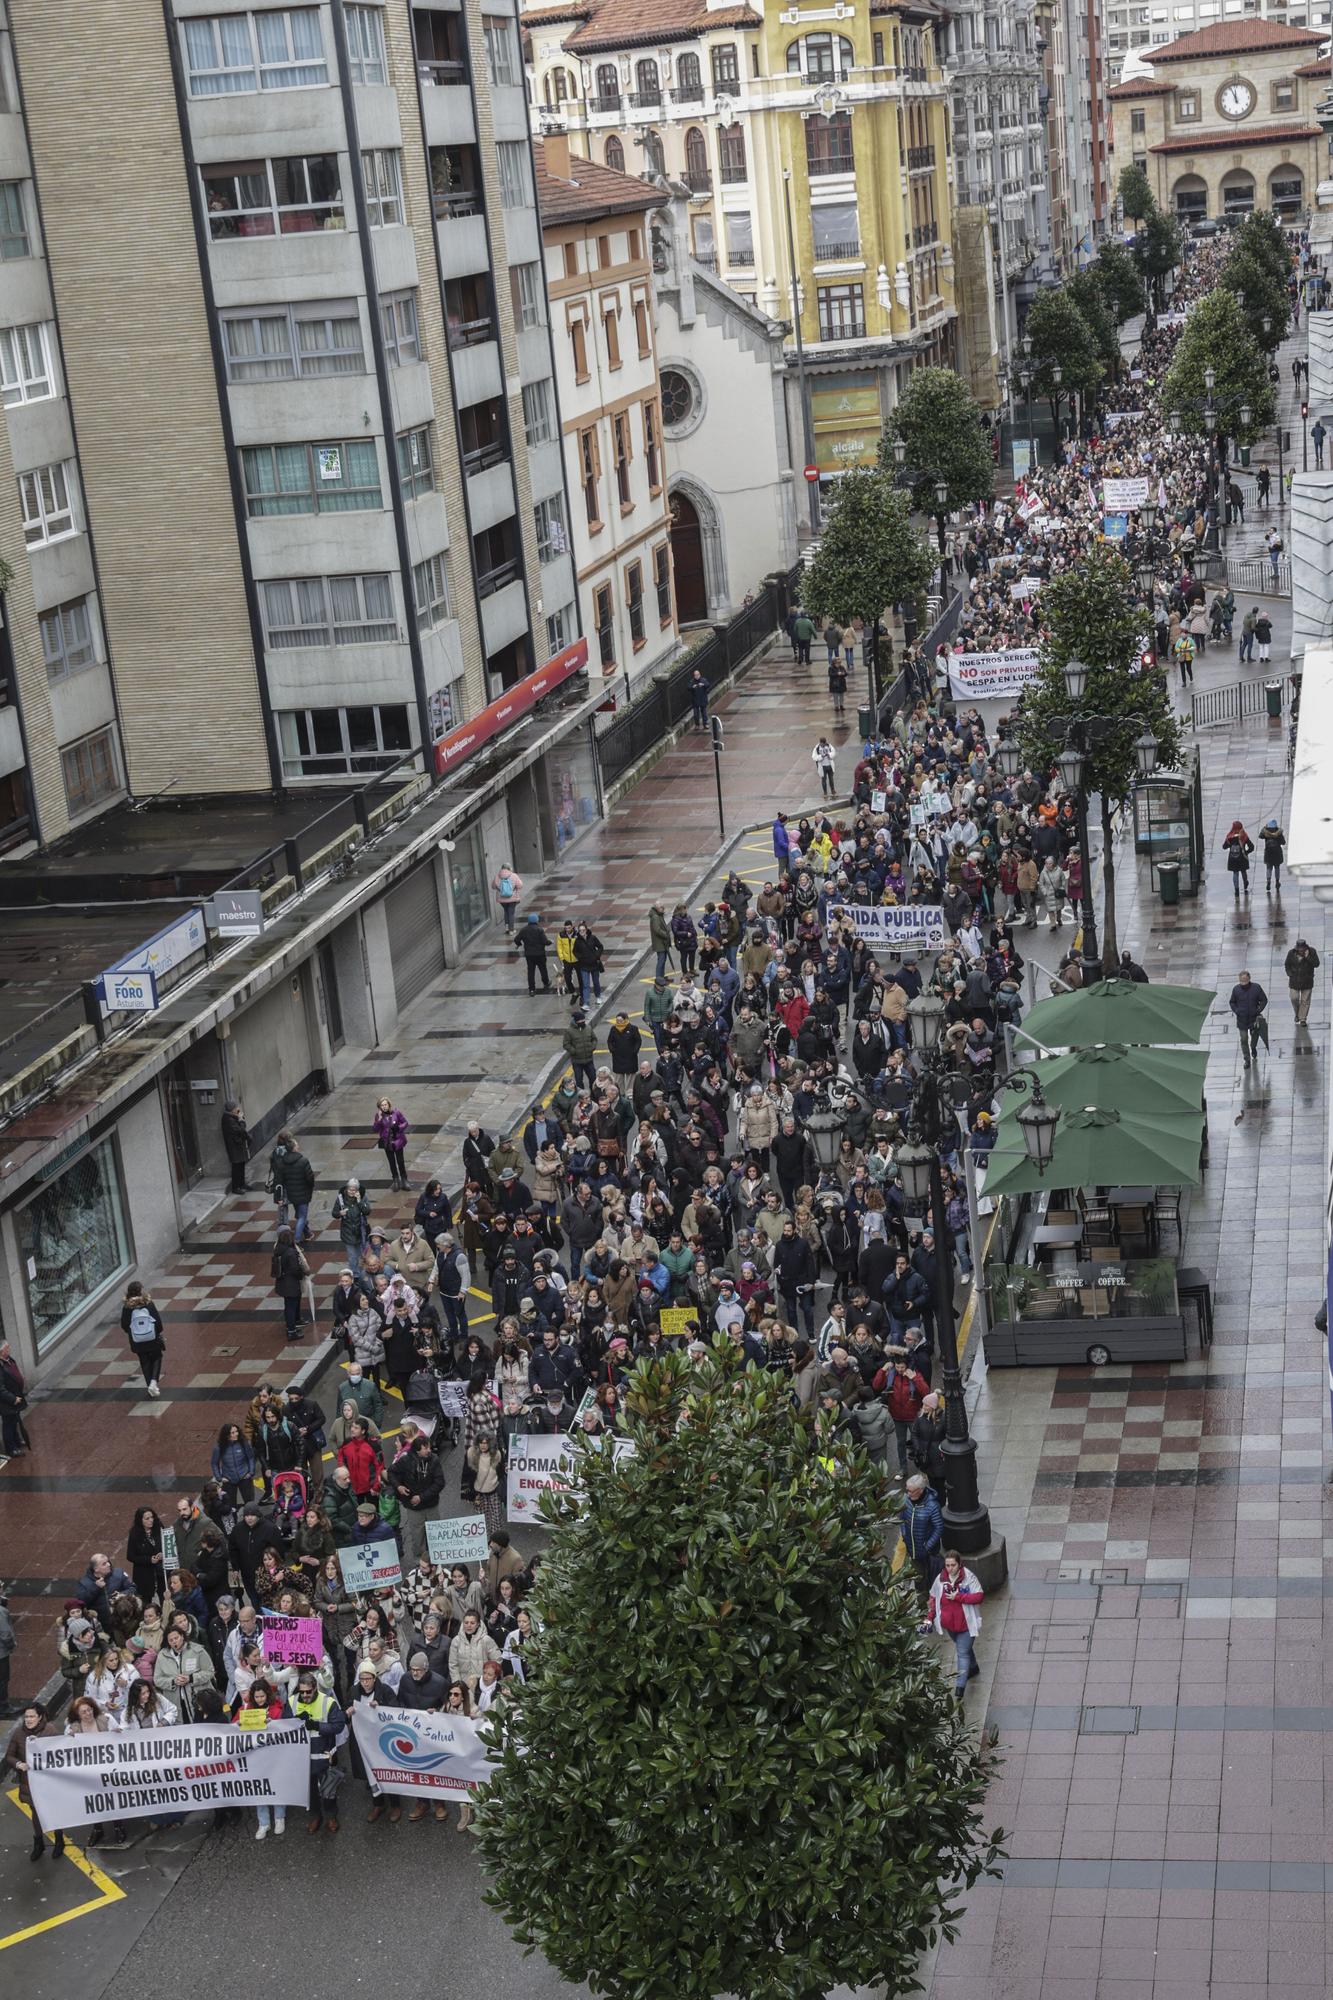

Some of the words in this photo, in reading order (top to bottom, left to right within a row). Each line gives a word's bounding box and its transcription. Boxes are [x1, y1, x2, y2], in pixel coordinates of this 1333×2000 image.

[959, 657, 1002, 667] NUESTROS
[960, 668, 978, 679] NO
[967, 678, 996, 687] SESPA
[219, 910, 257, 920] maestro
[115, 987, 143, 999] FORO
[116, 1000, 145, 1008] Asturias
[1056, 1278, 1084, 1287] COFFEE
[1098, 1277, 1126, 1286] COFFEE
[437, 1521, 486, 1541] APLAUSOS
[433, 1546, 485, 1561] DERECHOS
[371, 1566, 400, 1579] PRECARIO
[263, 1617, 299, 1631] NUESTROS
[268, 1651, 284, 1663] DEL
[288, 1652, 318, 1665] SESPA
[378, 1711, 394, 1723] Ola
[398, 1710, 411, 1722] de
[412, 1715, 422, 1730] la
[423, 1727, 455, 1742] Salud
[45, 1744, 115, 1769] ASTURIES
[118, 1741, 137, 1763] NA
[140, 1738, 192, 1761] LLUCHA
[195, 1735, 223, 1757] POR
[226, 1733, 252, 1754] UNA
[101, 1767, 163, 1787] PÚBLICA
[166, 1767, 184, 1782] DE
[419, 1774, 430, 1785] ES
[84, 1793, 115, 1814] NON
[118, 1786, 188, 1810] DEIXEMOS
[192, 1782, 219, 1803] QUE
[222, 1778, 276, 1798] MORRA.
